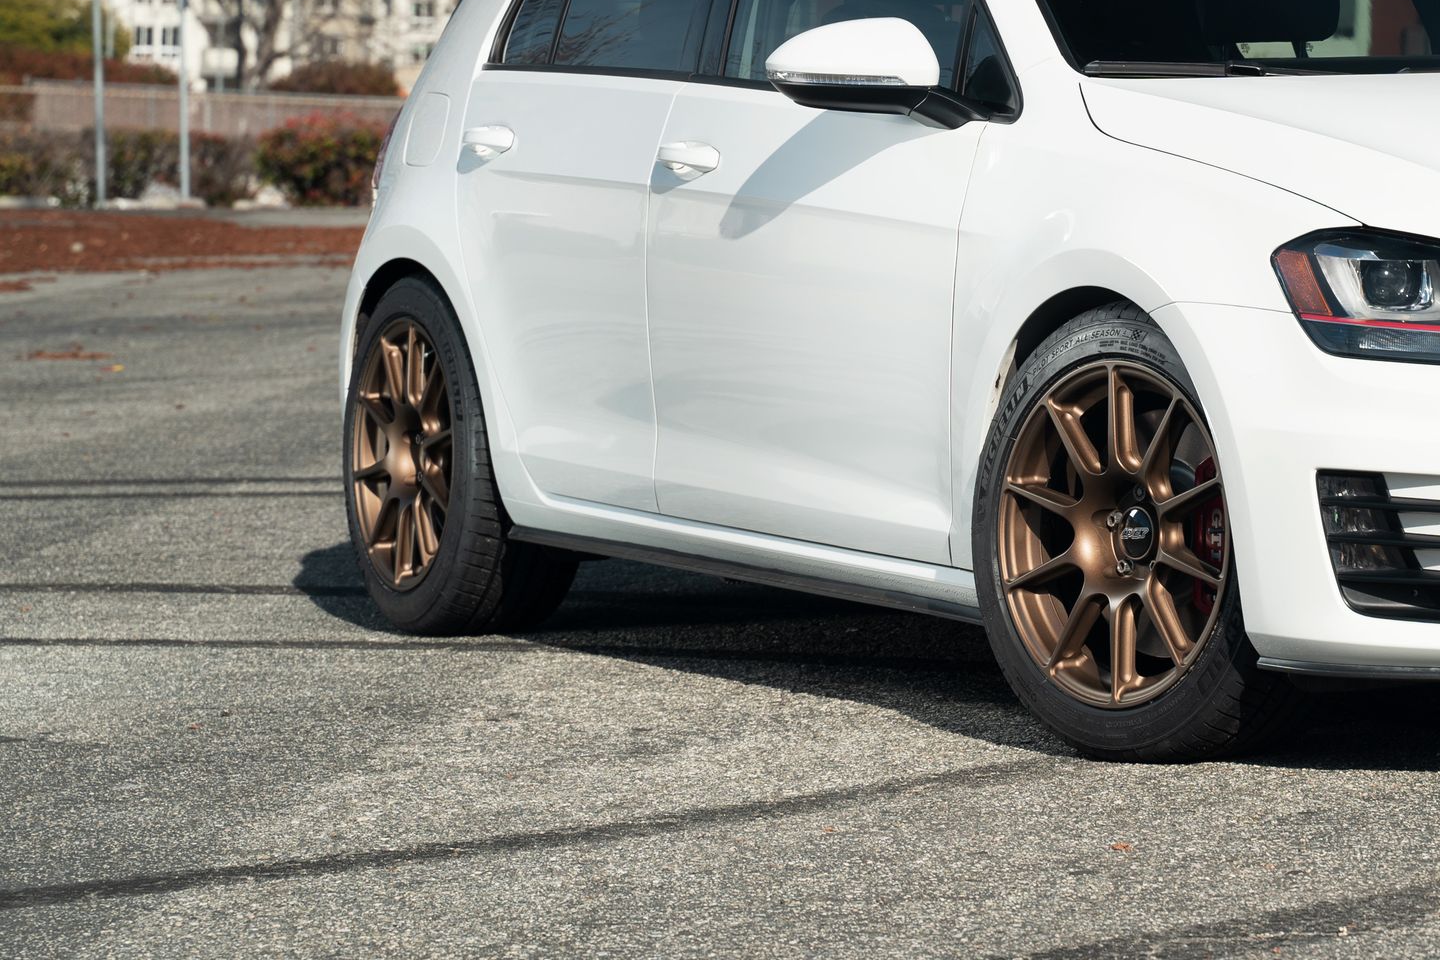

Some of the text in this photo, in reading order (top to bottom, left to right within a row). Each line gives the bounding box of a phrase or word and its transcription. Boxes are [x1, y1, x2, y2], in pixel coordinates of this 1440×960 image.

[980, 381, 1027, 487] MICHELIN
[1052, 339, 1074, 359] SPORT
[1090, 329, 1121, 339] SEASON
